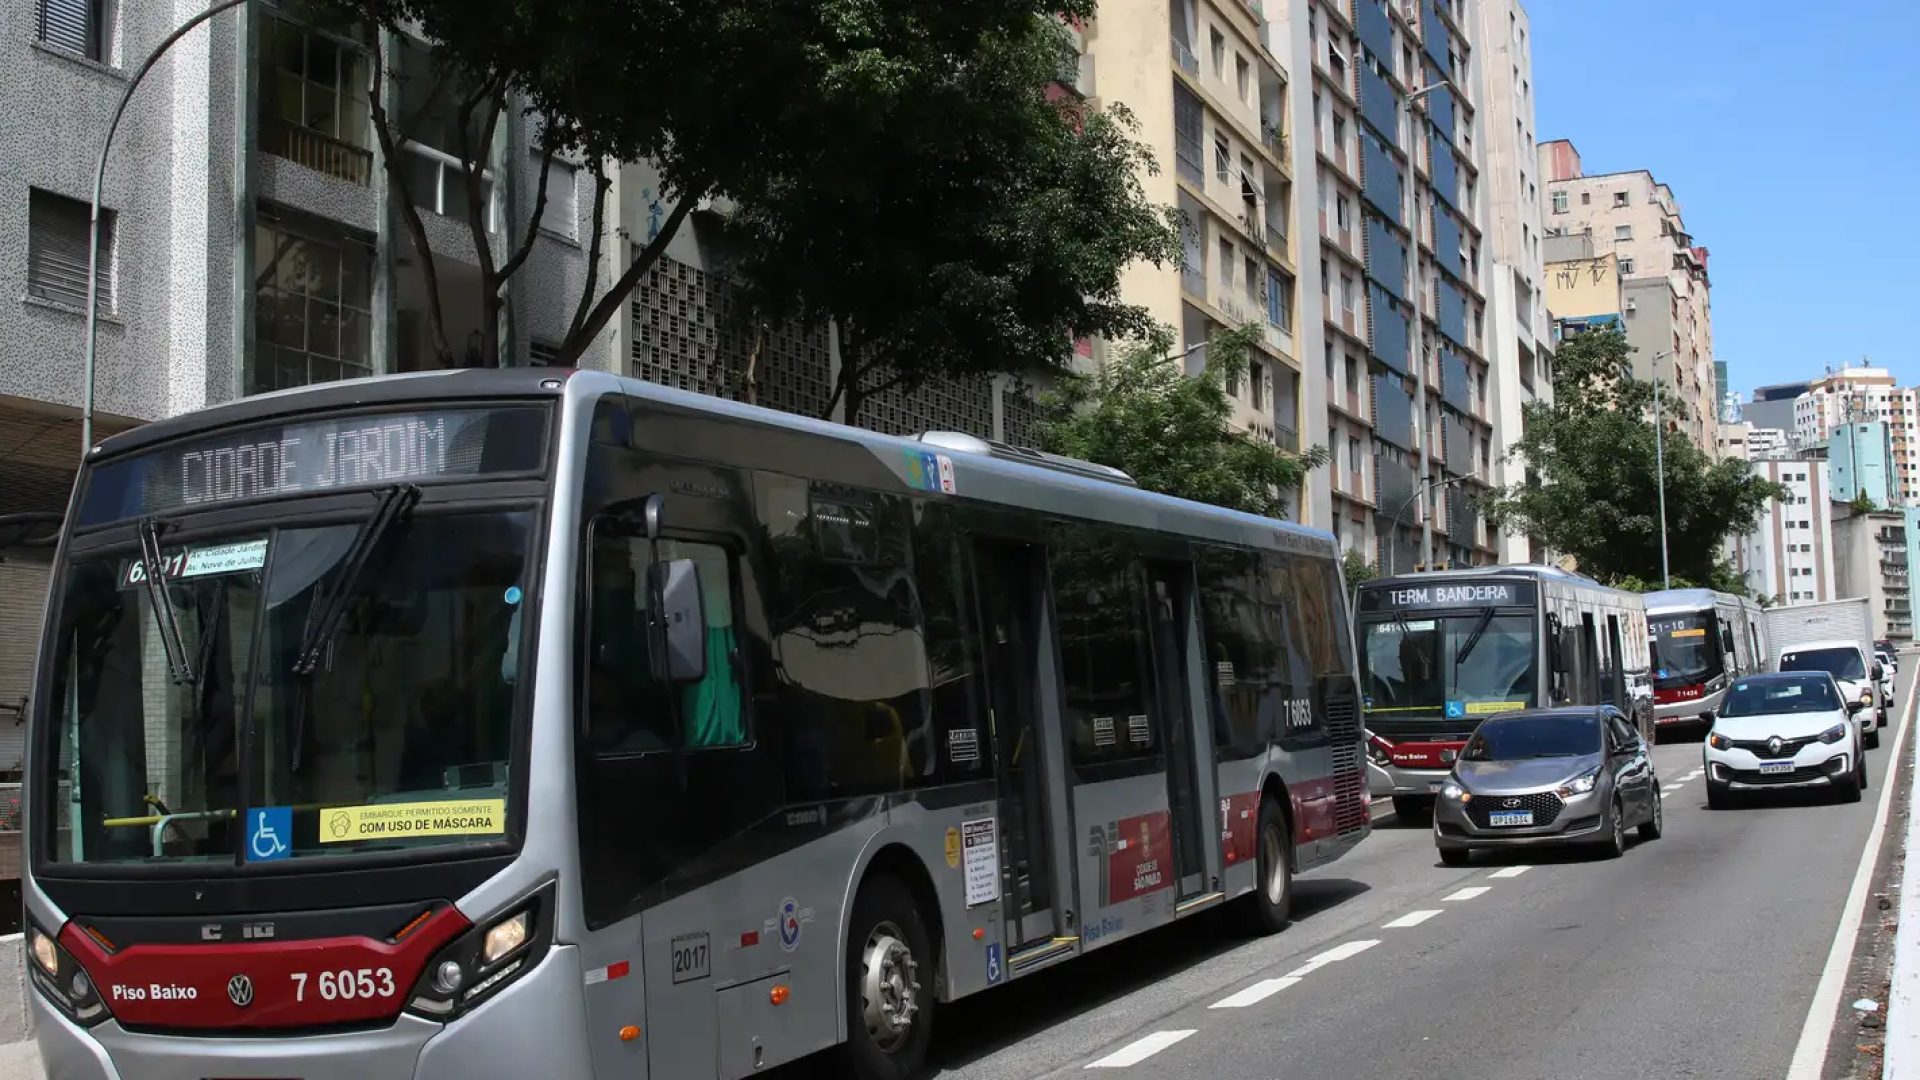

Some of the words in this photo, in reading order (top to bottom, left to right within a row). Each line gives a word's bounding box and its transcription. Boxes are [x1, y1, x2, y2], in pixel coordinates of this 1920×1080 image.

[182, 438, 300, 504] CIDADE
[317, 418, 445, 488] JARDIM
[201, 560, 223, 570] Nove
[225, 558, 235, 567] de
[1390, 588, 1430, 605] TERM.
[1436, 585, 1508, 603] BANDEIRA
[1291, 698, 1312, 727] 6053
[360, 810, 402, 821] EMBARQUE
[405, 807, 450, 817] PERMITIDO
[452, 805, 492, 815] SOMENTE
[359, 822, 385, 834] COM
[388, 820, 412, 832] USO
[415, 819, 430, 830] DE
[433, 816, 492, 829] MÁSCARA
[674, 944, 706, 972] 2017
[112, 984, 146, 1000] Piso
[150, 983, 197, 1000] Baixo
[291, 972, 308, 1001] 7
[319, 967, 395, 1000] 6053
